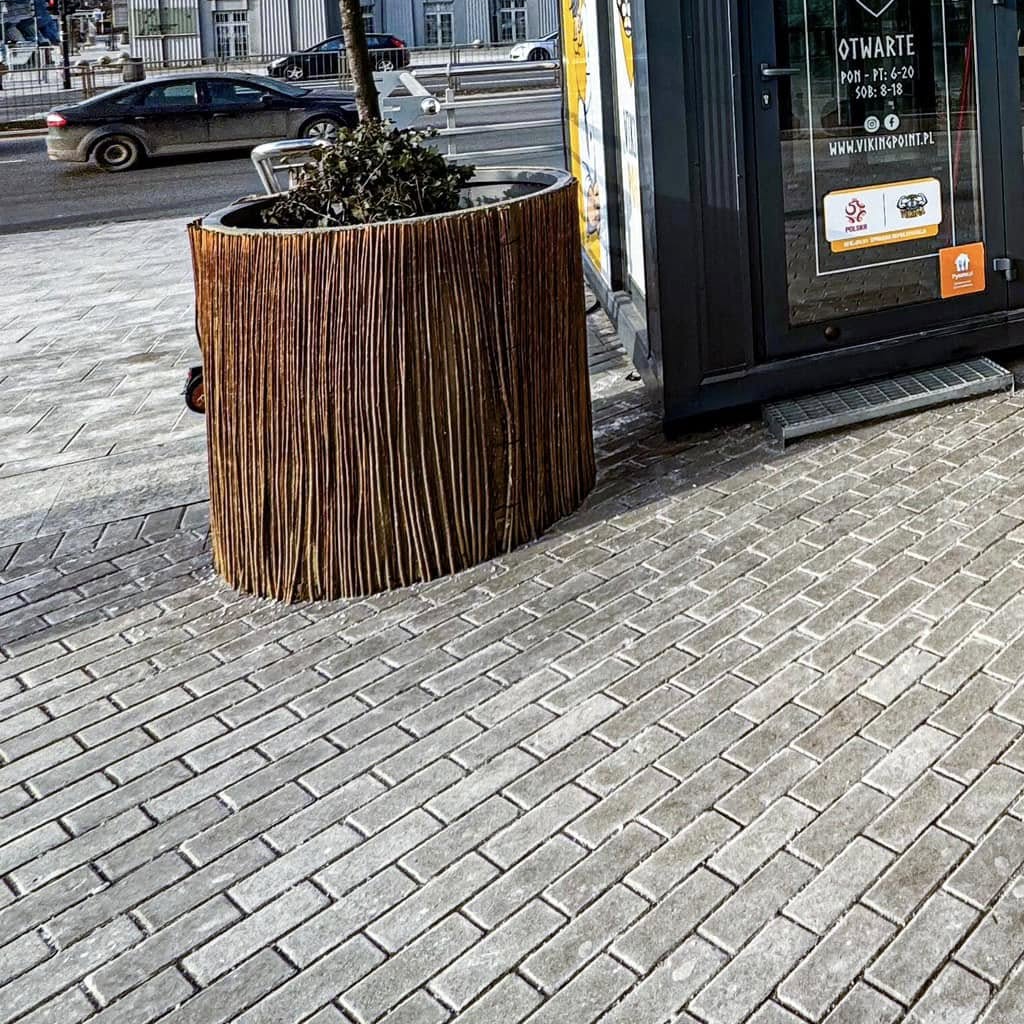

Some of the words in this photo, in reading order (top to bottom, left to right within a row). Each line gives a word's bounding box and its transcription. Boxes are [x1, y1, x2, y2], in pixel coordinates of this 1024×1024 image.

[839, 34, 915, 60] OTWARTE
[841, 70, 861, 85] PON
[873, 67, 888, 81] PT:
[890, 65, 915, 80] 6-20
[855, 85, 877, 99] SOB:
[880, 82, 903, 97] 8-18
[829, 131, 935, 156] WWW.VIKINGPOINT.PL
